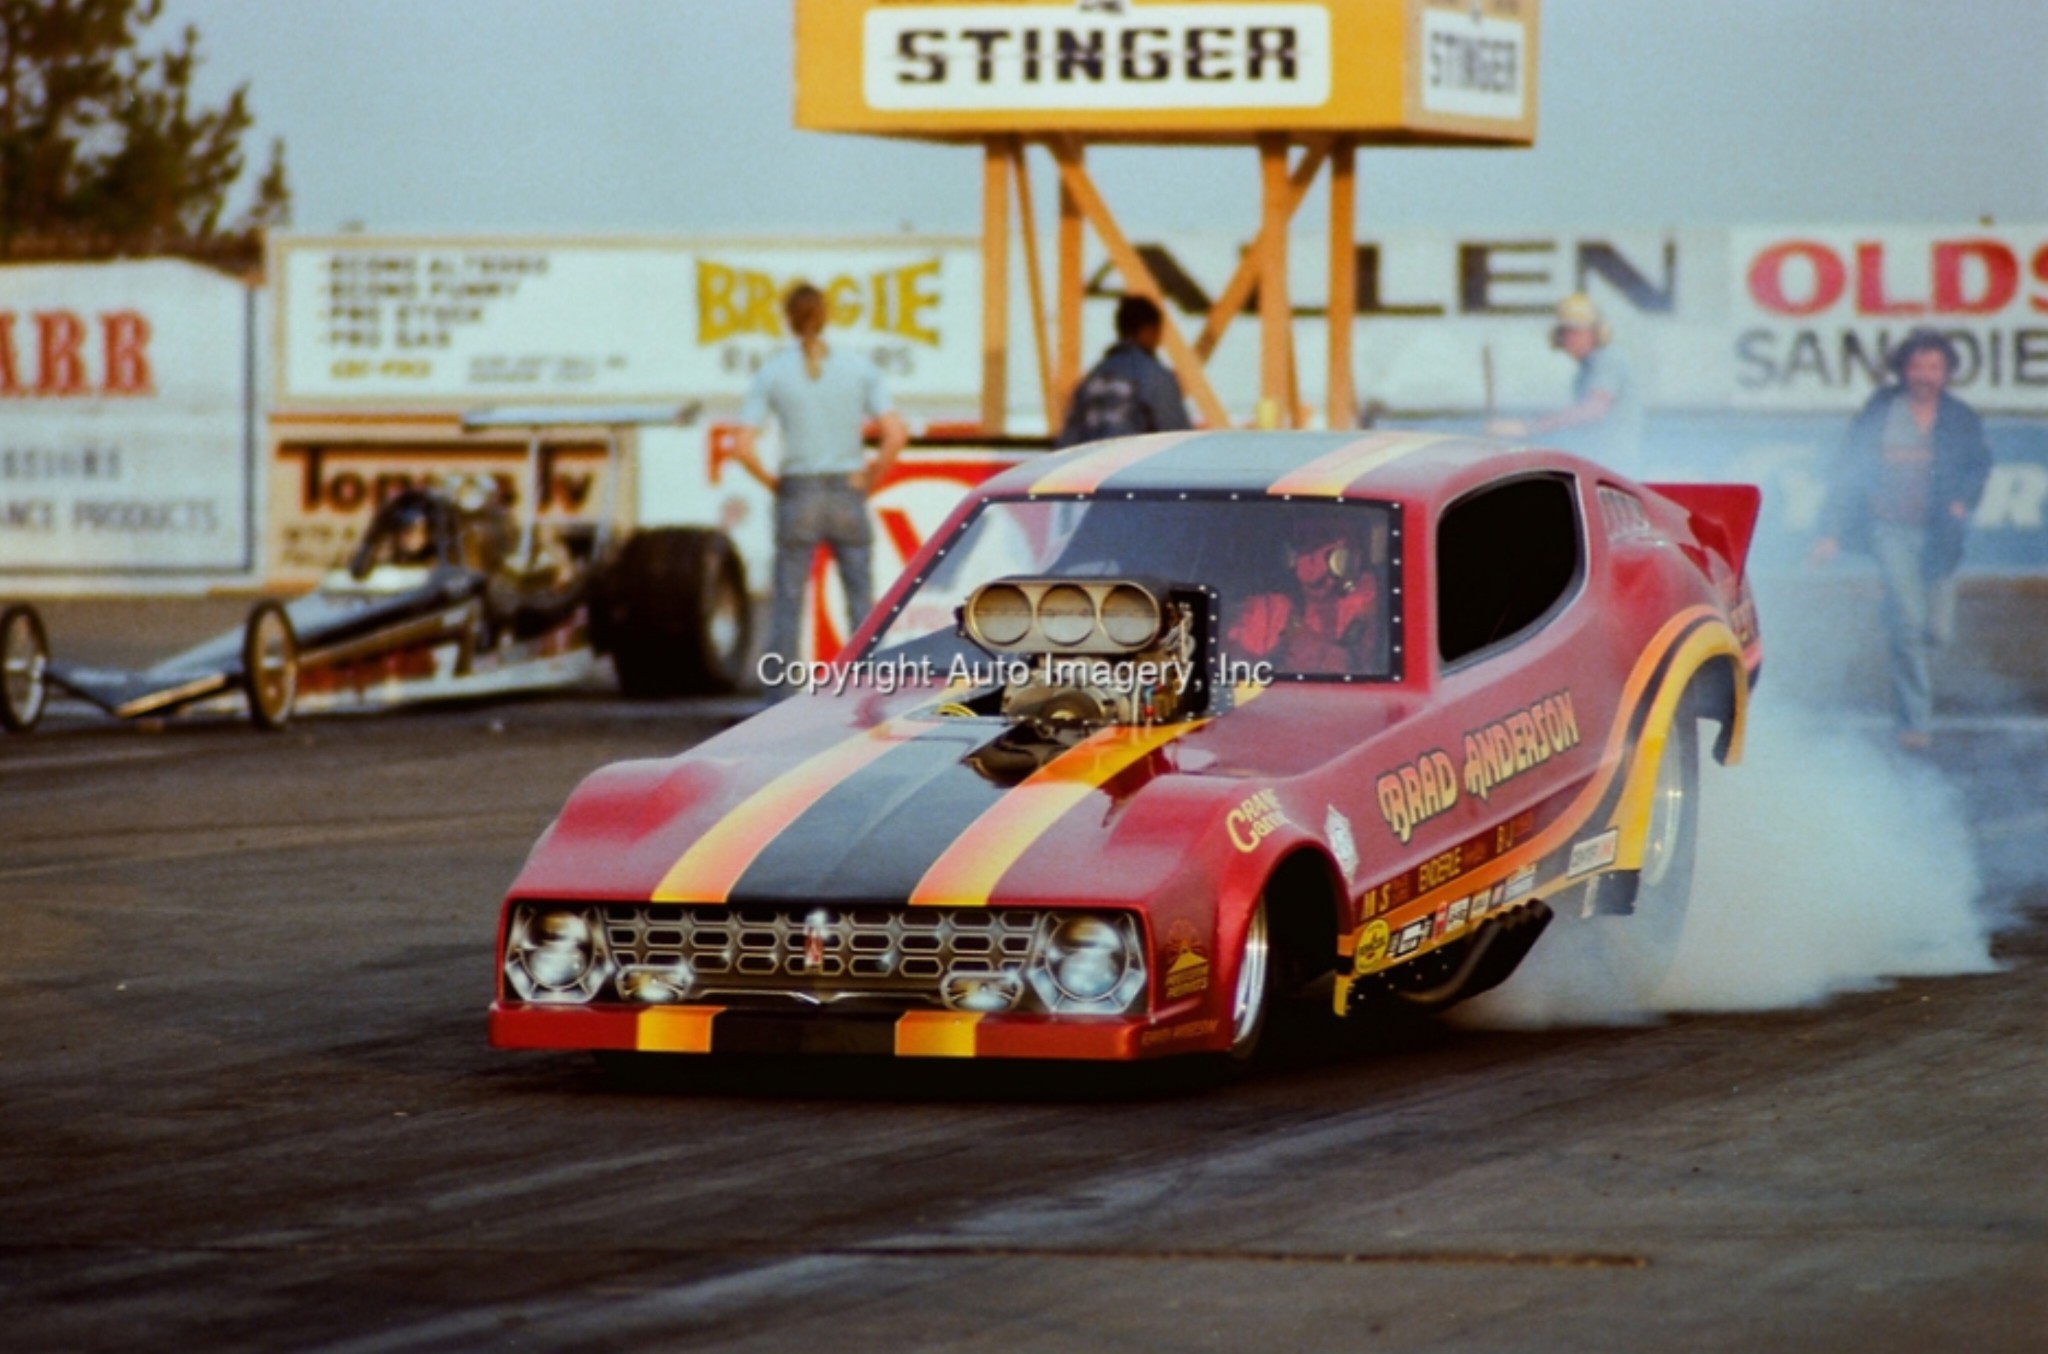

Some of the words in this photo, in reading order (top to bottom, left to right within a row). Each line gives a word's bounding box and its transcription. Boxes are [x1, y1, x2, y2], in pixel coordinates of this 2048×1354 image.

[896, 27, 1298, 84] STINGER
[1430, 29, 1517, 96] STINGER
[697, 258, 942, 347] BRGIE
[1735, 328, 1888, 388] SAN
[1375, 747, 1459, 844] BRAD
[1463, 687, 1581, 804] ANDERSON
